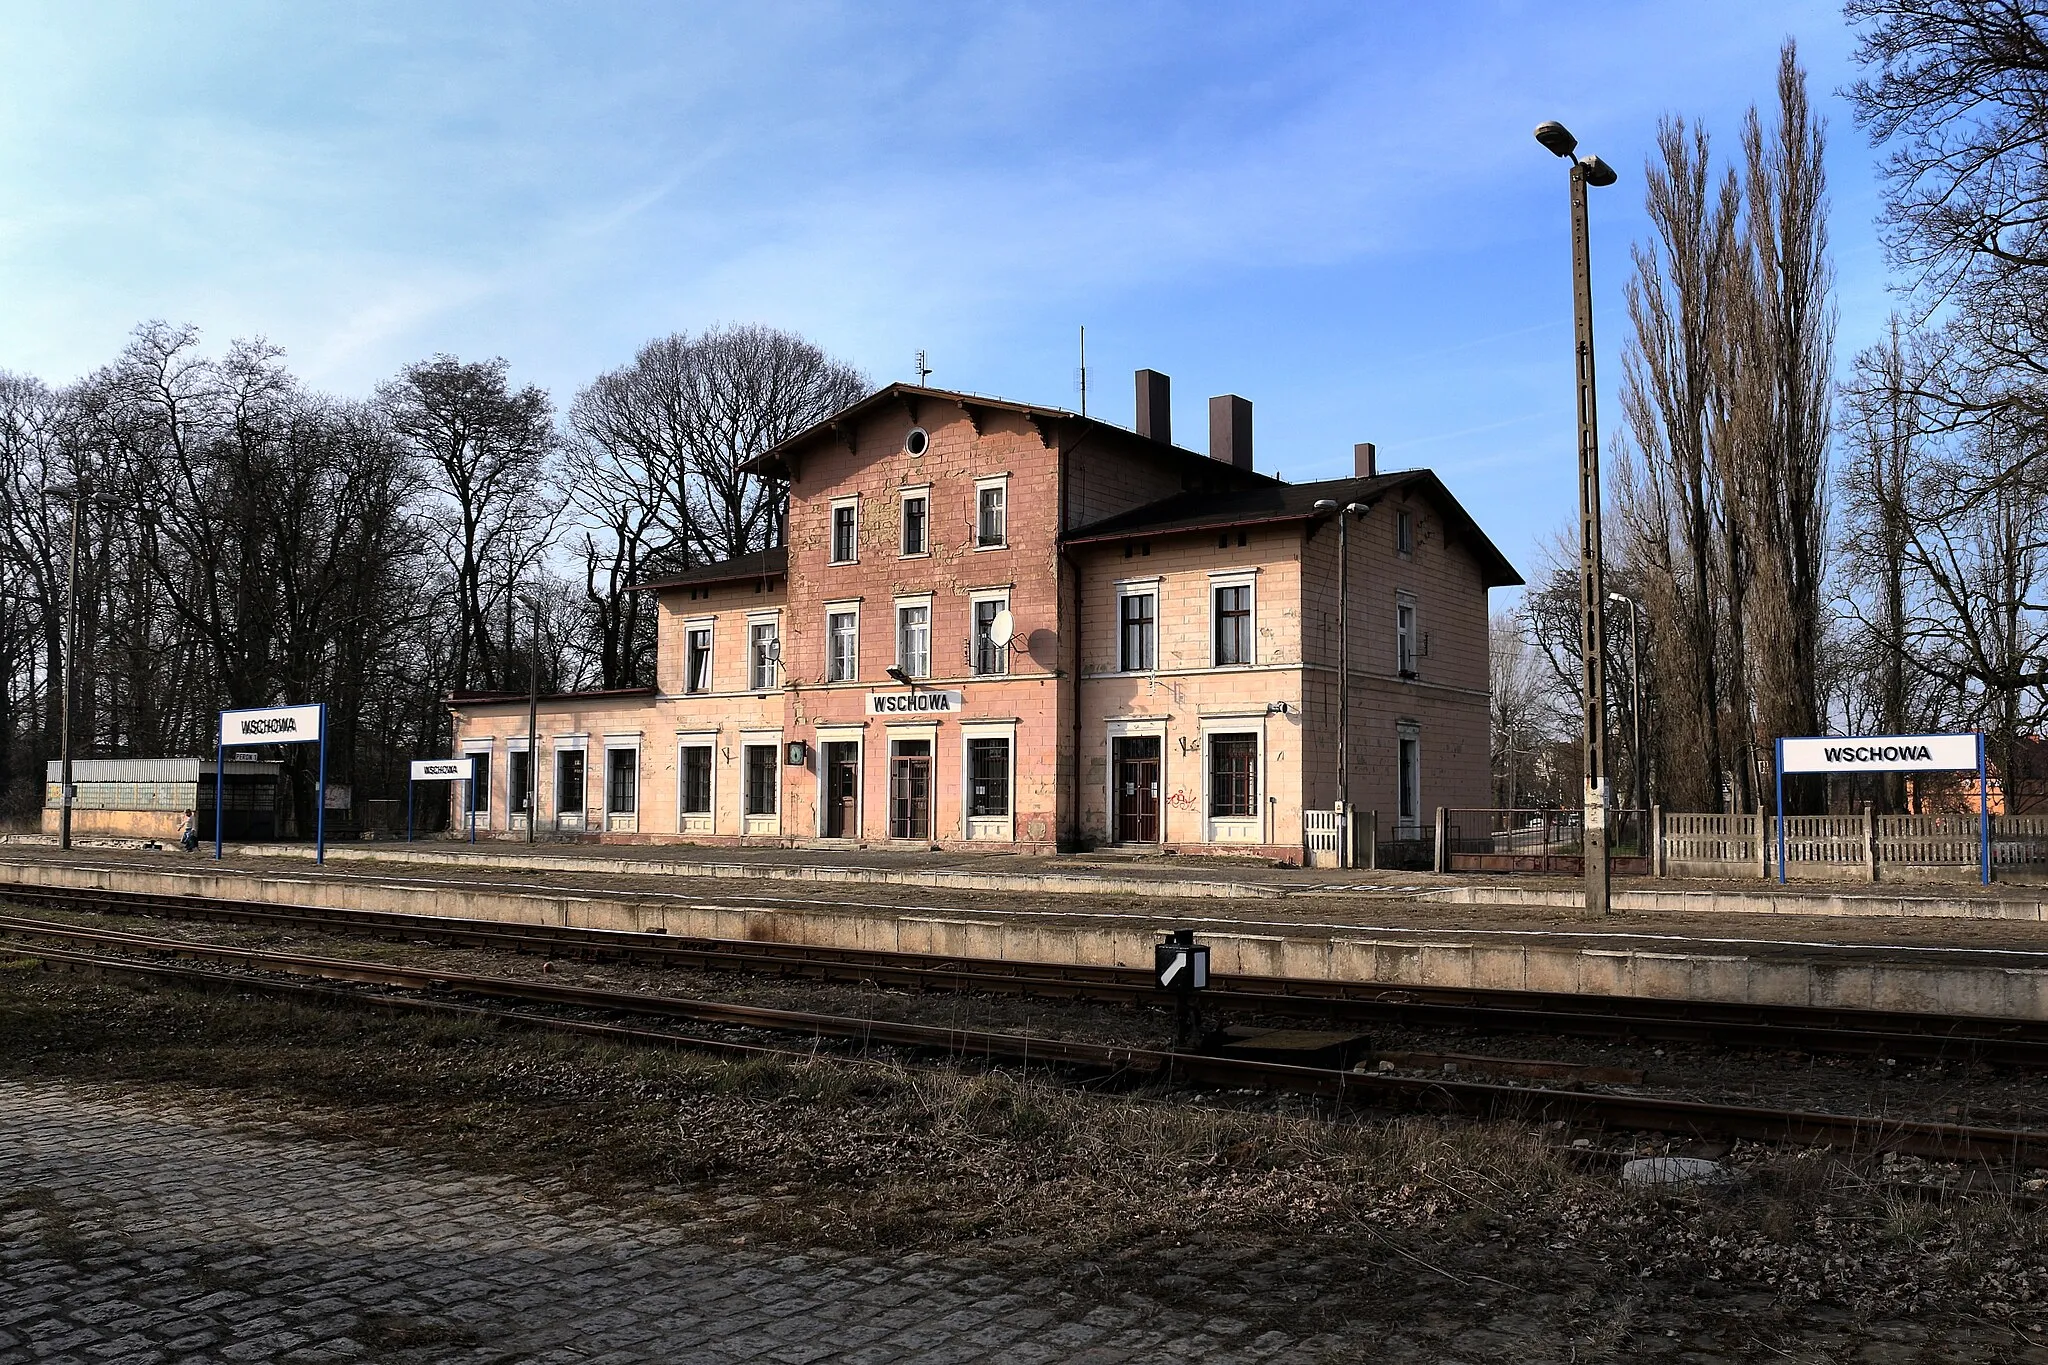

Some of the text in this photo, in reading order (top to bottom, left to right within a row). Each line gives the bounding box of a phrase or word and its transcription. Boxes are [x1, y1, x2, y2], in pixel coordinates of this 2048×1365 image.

[874, 694, 950, 712] WSCHOWA
[241, 718, 297, 734] WSCHOWA
[1824, 745, 1933, 762] WSCHOWA
[423, 765, 458, 775] WSCHOWA
